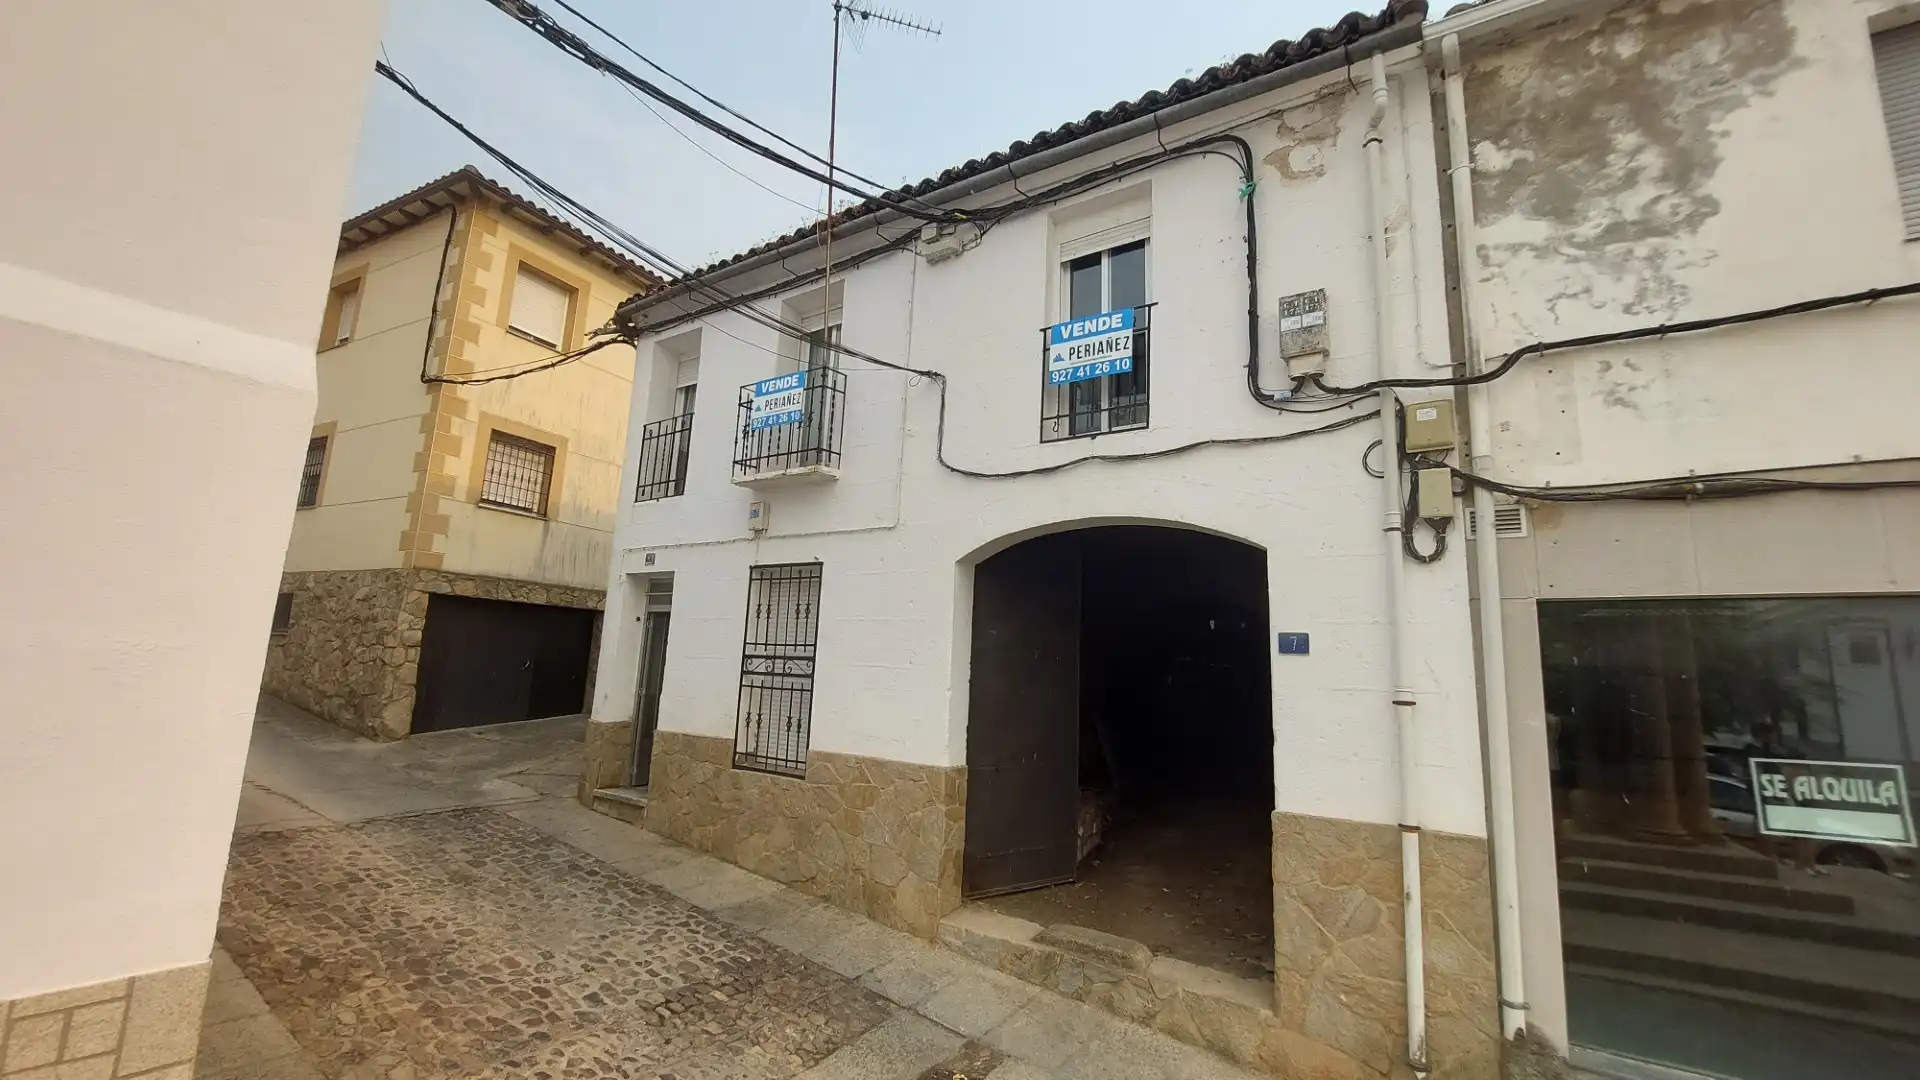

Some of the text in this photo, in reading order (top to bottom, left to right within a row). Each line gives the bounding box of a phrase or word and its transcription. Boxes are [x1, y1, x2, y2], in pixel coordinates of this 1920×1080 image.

[1060, 313, 1123, 339] VENDE
[1068, 336, 1130, 361] PERIAÑEZ
[1052, 368, 1073, 382] 927
[1076, 366, 1090, 377] 41
[1095, 361, 1110, 374] 26
[1114, 358, 1130, 371] 10
[761, 374, 799, 394] VENDE
[764, 392, 801, 411] PERIAÑEZ
[752, 417, 766, 428] 927
[768, 415, 776, 424] 41
[779, 412, 788, 421] 26
[790, 411, 800, 419] 10
[1290, 636, 1297, 651] 7
[1760, 773, 1899, 807] SE ALQUILA
